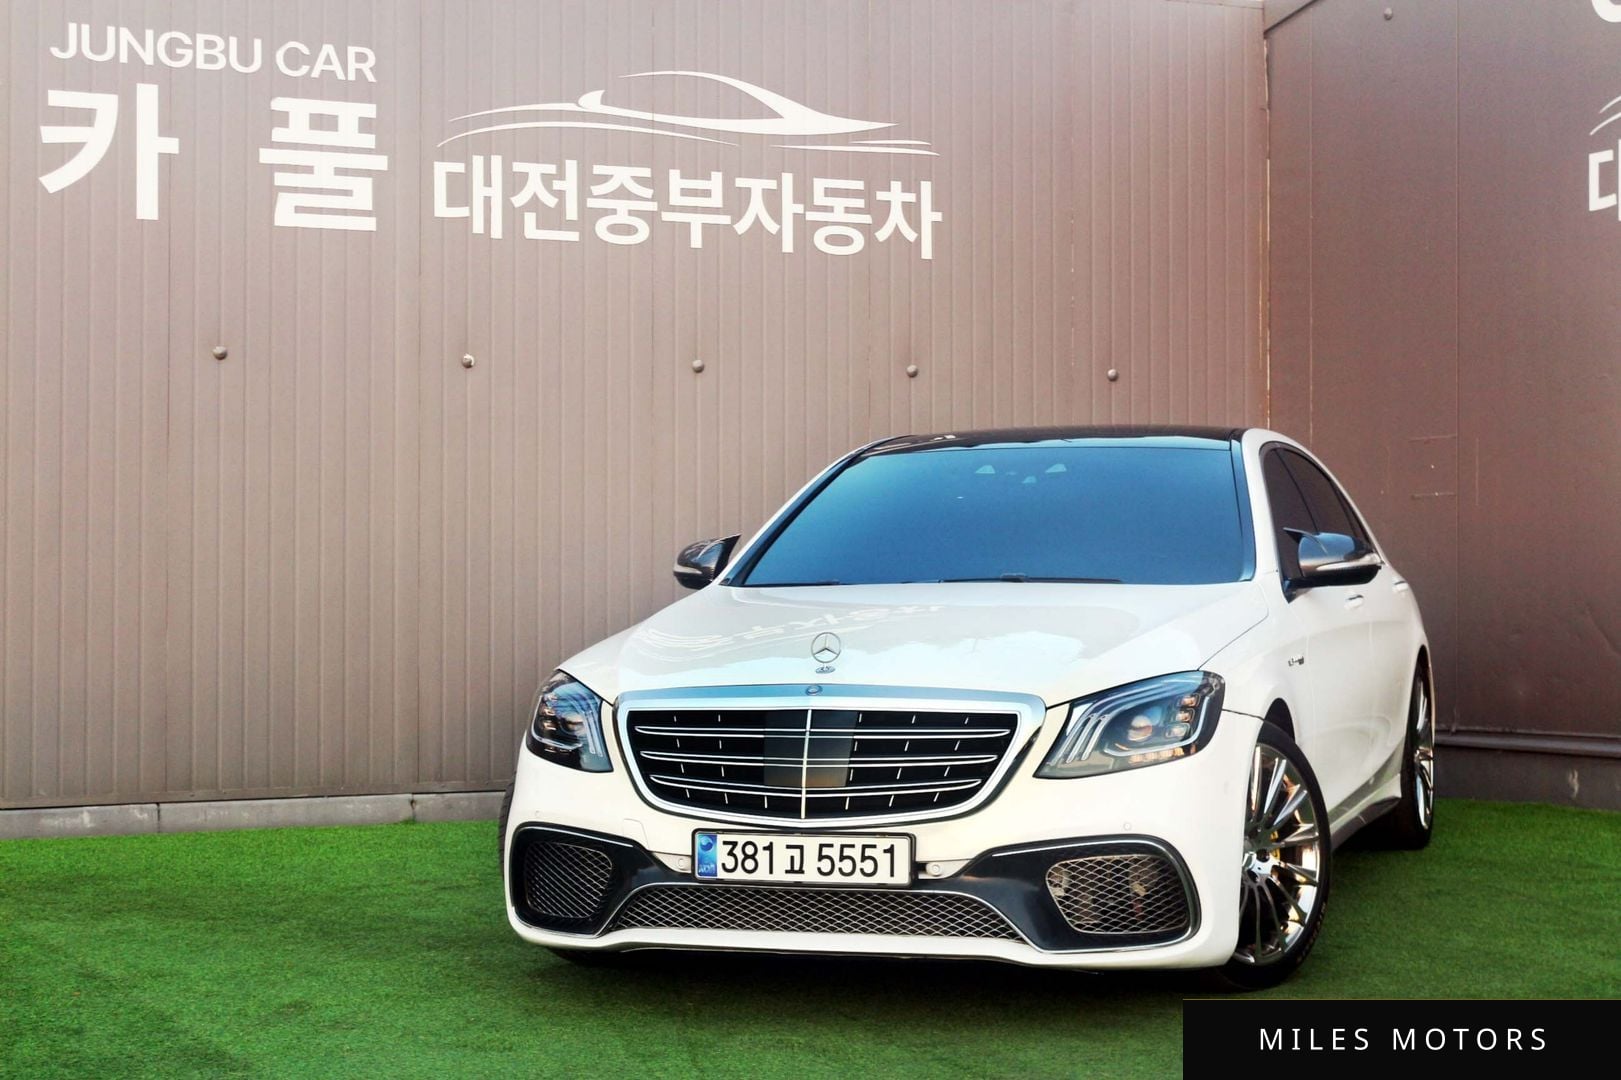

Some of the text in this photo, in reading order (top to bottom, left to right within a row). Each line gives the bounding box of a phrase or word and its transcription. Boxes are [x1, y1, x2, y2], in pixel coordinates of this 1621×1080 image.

[50, 22, 377, 82] JUNGBU CAR
[433, 154, 943, 260] 대전중부자동차
[816, 843, 895, 878] 5551
